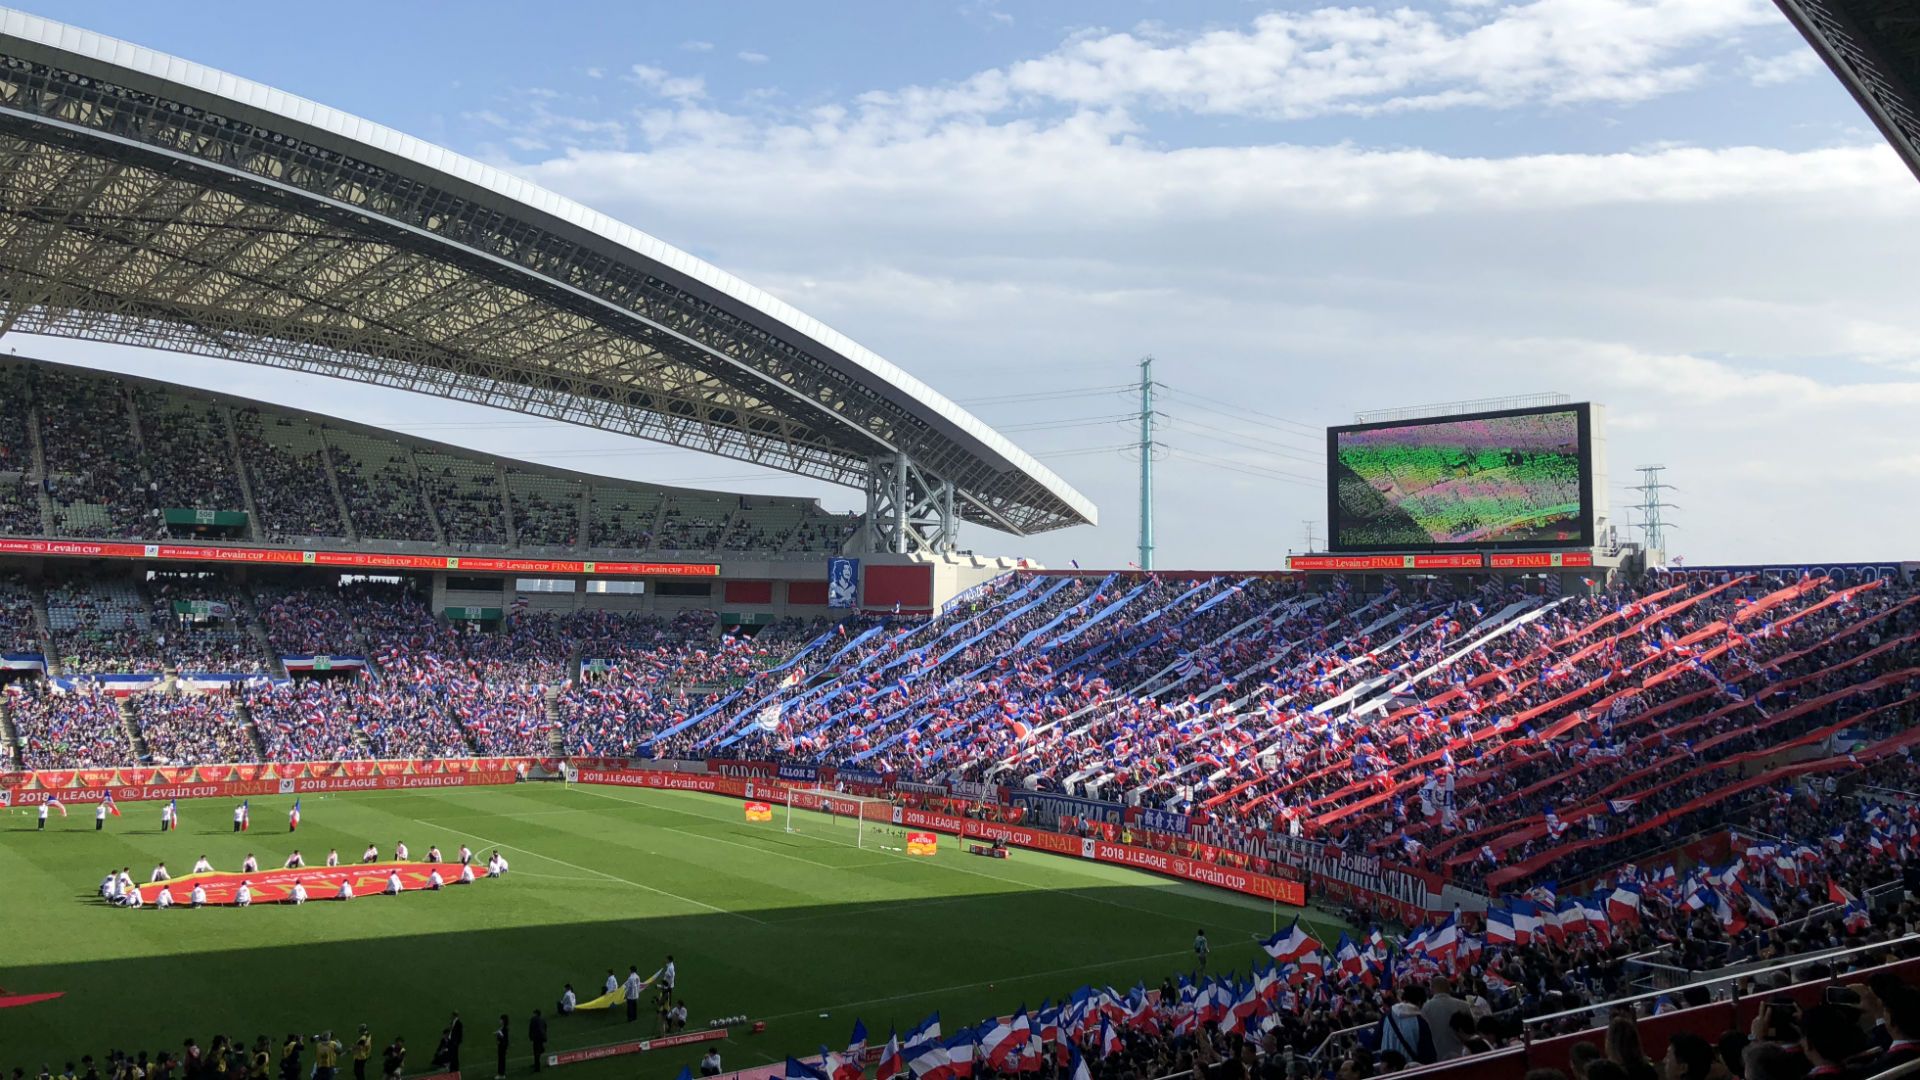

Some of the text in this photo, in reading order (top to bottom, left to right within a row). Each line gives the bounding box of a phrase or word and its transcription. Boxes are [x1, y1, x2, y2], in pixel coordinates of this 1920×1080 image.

[47, 543, 81, 553] Levain
[216, 550, 246, 559] Levain
[267, 552, 299, 560] FINAL
[367, 556, 395, 565] Levain
[414, 558, 442, 566] FINAL
[1517, 556, 1547, 565] FINAL
[507, 562, 533, 570] Levain
[551, 563, 579, 571] FINAL
[1336, 559, 1361, 567] Levain
[1372, 557, 1400, 566] FINAL
[642, 565, 667, 573] Levain
[301, 780, 327, 789] 2018
[329, 778, 378, 788] J.LEAGUE
[403, 775, 441, 787] Levain
[443, 776, 464, 785] CUP
[468, 772, 507, 783] FINAL
[583, 772, 603, 782] 2018
[604, 774, 643, 784] J.LEAGUE
[664, 776, 697, 788] Levain
[699, 782, 715, 790] CUP
[19, 792, 49, 802] 2018
[143, 785, 190, 798] Levain
[192, 786, 217, 796] CUP
[224, 782, 272, 793] FINAL
[757, 788, 771, 798] 2018
[772, 790, 800, 803] J.LEAUE
[840, 803, 855, 812] CUP
[1144, 810, 1186, 832] 飯倉大樹
[907, 812, 924, 823] 2018
[926, 815, 960, 830] J.LEAGUE
[980, 822, 1012, 841] Levain
[1013, 832, 1031, 844] CUP
[1037, 833, 1075, 852] FINAL
[1101, 846, 1124, 860] 2018
[1126, 850, 1167, 869] J.LEAGUE
[1189, 862, 1224, 884] Levain
[1225, 874, 1246, 888] CUP
[1252, 876, 1296, 901] FINAL
